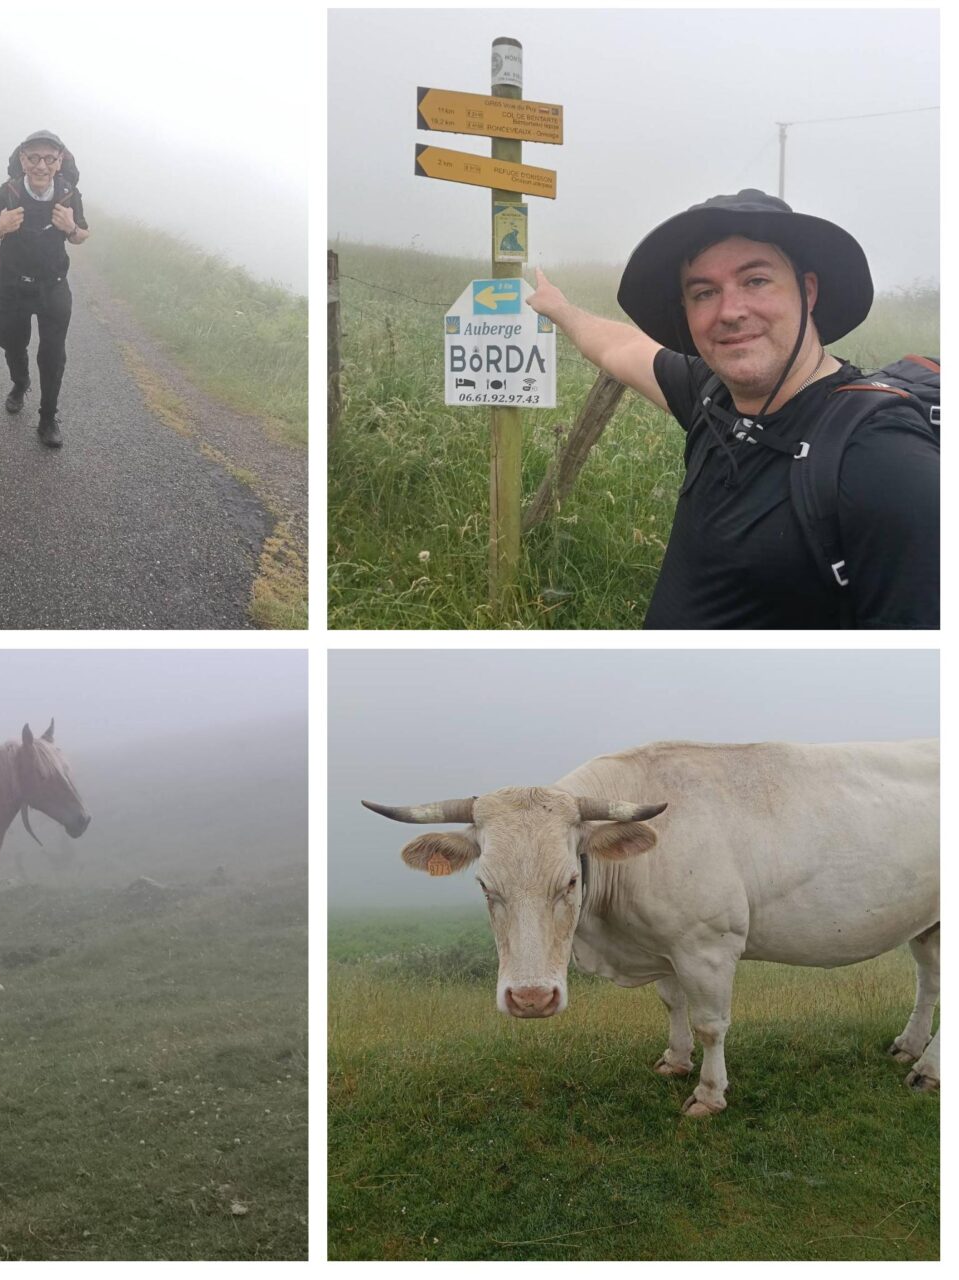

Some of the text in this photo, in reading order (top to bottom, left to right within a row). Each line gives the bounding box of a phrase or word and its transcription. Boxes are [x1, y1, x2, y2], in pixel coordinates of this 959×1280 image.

[502, 111, 515, 119] COL
[493, 166, 519, 177] REFUGE
[464, 321, 522, 339] Auberge
[458, 393, 540, 404] 06.61.92.97.43
